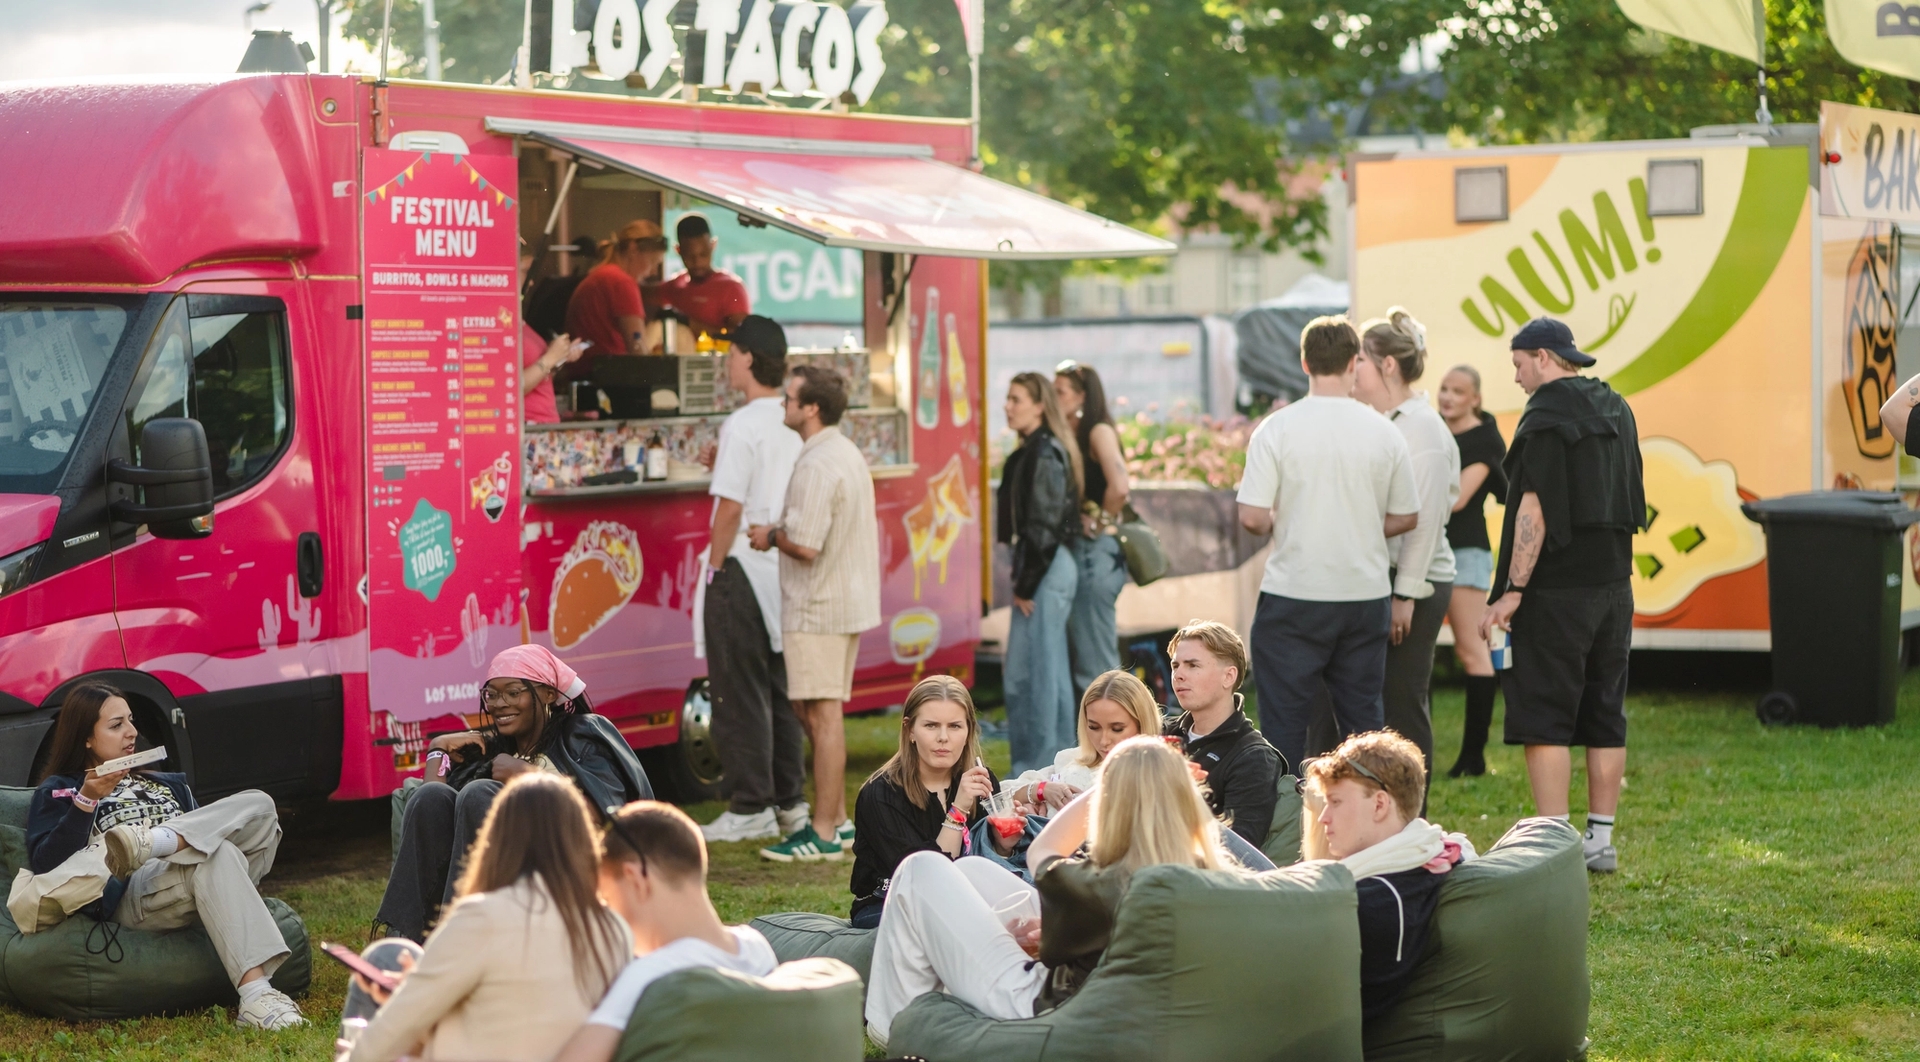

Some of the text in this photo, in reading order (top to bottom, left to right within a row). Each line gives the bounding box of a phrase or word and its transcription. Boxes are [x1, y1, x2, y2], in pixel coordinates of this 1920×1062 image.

[550, 0, 889, 107] LOS TACOS
[390, 196, 494, 227] FESTIVAL
[415, 228, 477, 257] MENU
[372, 272, 509, 288] BURRITOS, BOWLS & NACHOS
[463, 316, 496, 329] EXTRAS
[51, 342, 68, 382] PREMIUM
[411, 544, 451, 579] 1000,-
[425, 681, 480, 705] LOS TACOS
